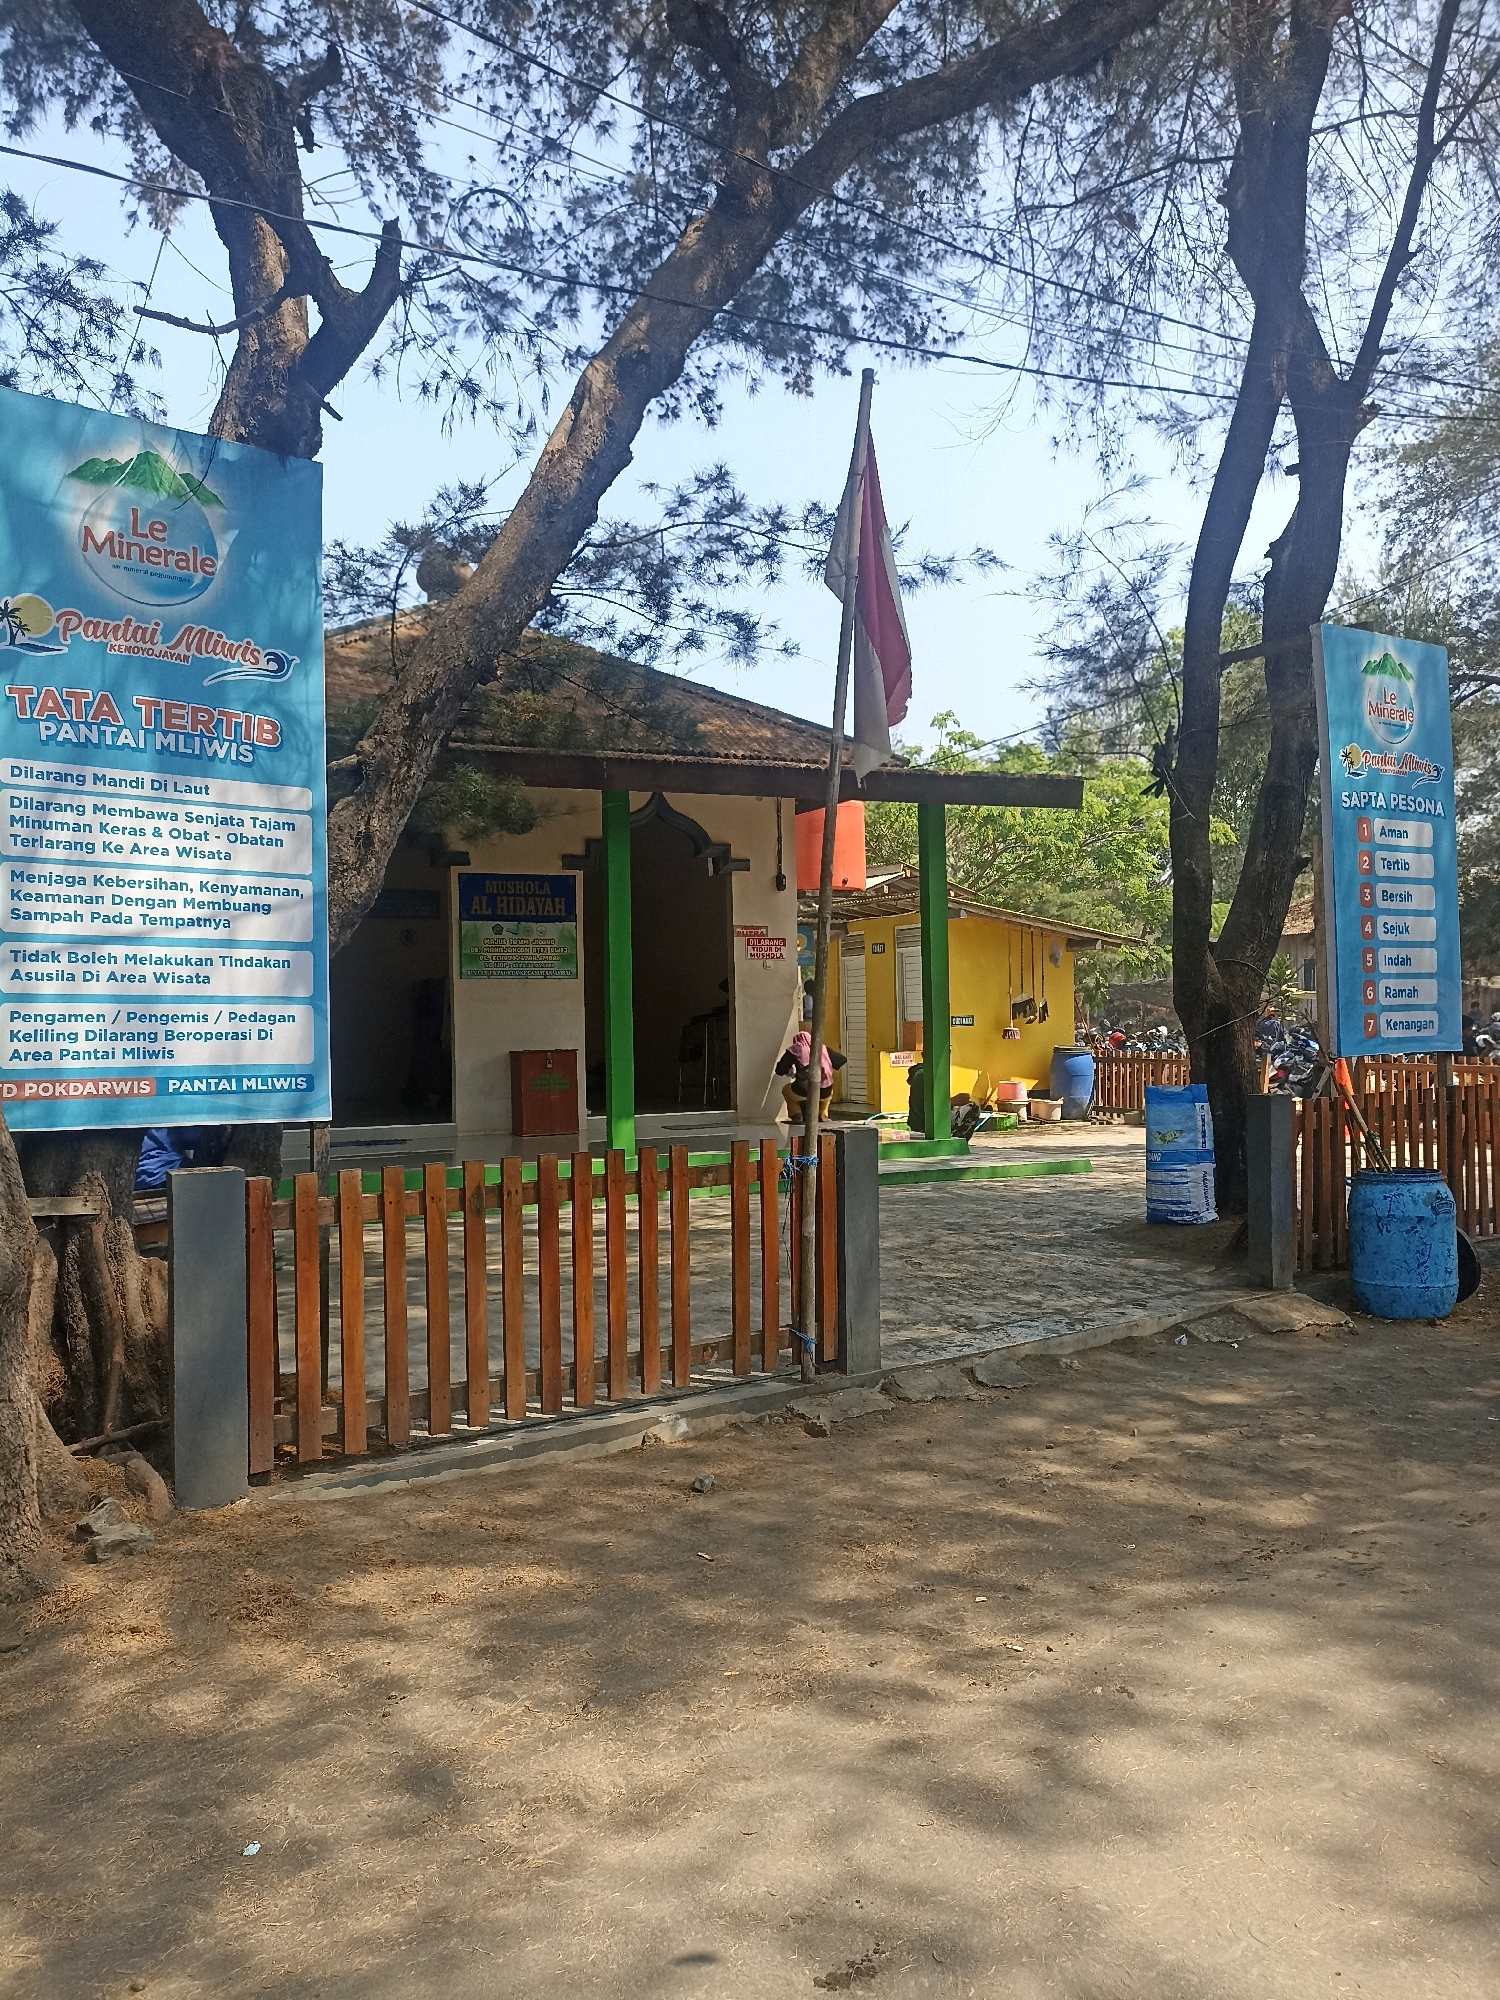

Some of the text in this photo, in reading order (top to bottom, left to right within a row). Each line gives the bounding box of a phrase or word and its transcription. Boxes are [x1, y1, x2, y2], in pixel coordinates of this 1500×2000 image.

[131, 507, 168, 541] Le
[81, 524, 217, 577] Minerale
[123, 565, 149, 574] mineral
[55, 610, 262, 666] Pantai Mliwis
[108, 642, 190, 665] KENOYOJAYAN
[1383, 687, 1397, 706] Le
[6, 686, 280, 746] TATA TERTIB
[1368, 700, 1415, 723] Minerale
[40, 721, 254, 763] PANTAI MLIWIS
[1362, 750, 1432, 775] Pantai Mliwis
[10, 765, 210, 796] Dilarang Mandi Di Laut
[9, 796, 296, 832] Dilarang Membawa Senjata Tajam
[1341, 791, 1445, 817] SAPTA PESONA
[10, 815, 93, 834] Minuman
[100, 822, 147, 838] Keras
[152, 826, 163, 838] &
[169, 827, 210, 842] Obat
[226, 832, 284, 848] Obatan
[1362, 823, 1409, 839] 1 Aman
[10, 833, 232, 861] Terlarang Ke Area Wisata
[1362, 856, 1410, 872] 2 Tertib
[10, 869, 304, 900] Menjaga Kebersihan, Kenyamanan,
[485, 880, 551, 895] MUSHOLA
[10, 888, 272, 915] Keamanan Dengan Membuang
[471, 895, 566, 916] AL HIDAYAH
[1364, 888, 1413, 903] 3 Bersih
[10, 907, 231, 930] Sampah Pada Tempatnya
[1364, 921, 1410, 937] 4 Sejuk
[749, 938, 784, 946] DILARANG
[10, 949, 291, 969] Tidak Boleh Melakukan Tindakan
[1366, 953, 1412, 967] 5 Indah
[10, 968, 211, 985] Asusila Di Area Wisata
[1366, 986, 1419, 999] 6 Ramah
[9, 1009, 296, 1026] Pengamen / Pengemis / Pedagan
[1367, 1018, 1435, 1033] 7 Kenangan
[9, 1028, 273, 1045] Keliling Dilarang Beroperasi Di
[9, 1046, 175, 1062] Area Pantai Mliwis
[0, 1076, 308, 1098] D POKDARWIS PANTAI MLIWIS
